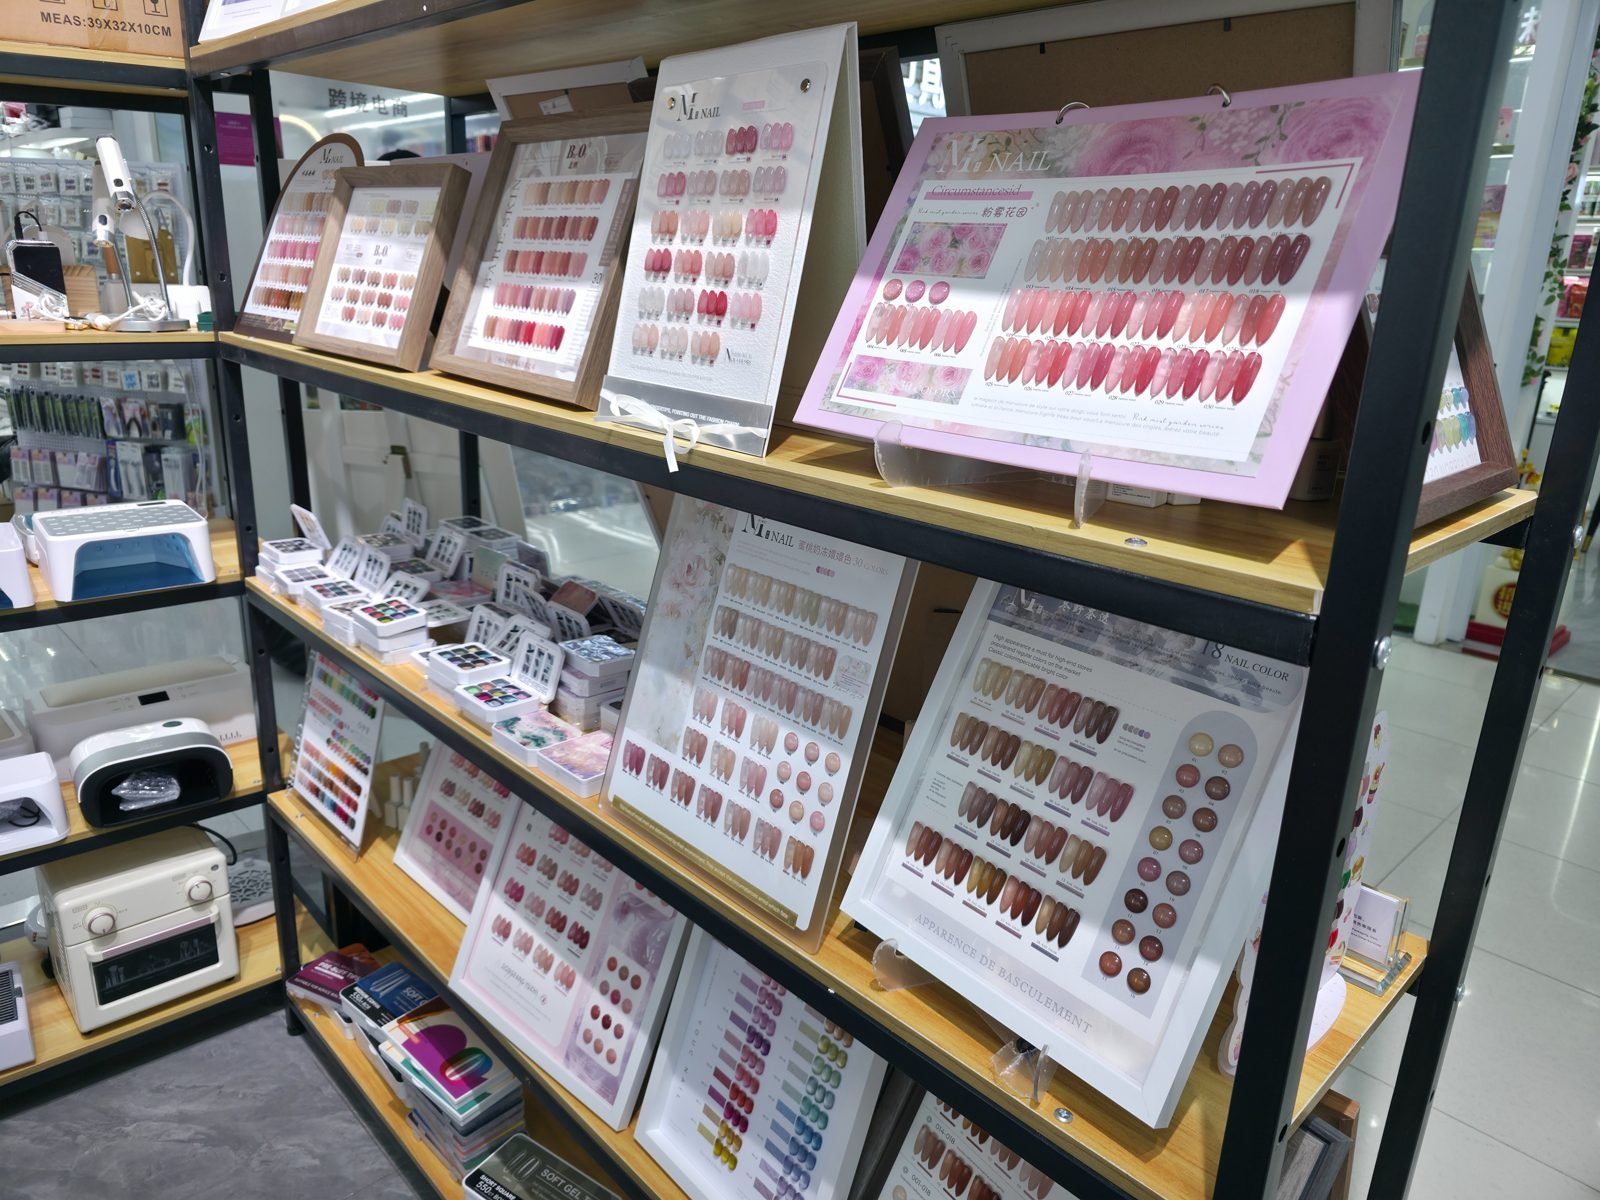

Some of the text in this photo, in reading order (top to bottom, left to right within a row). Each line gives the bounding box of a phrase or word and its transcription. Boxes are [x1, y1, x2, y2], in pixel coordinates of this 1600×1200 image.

[40, 11, 172, 37] MEAS:39X32X10CM
[328, 88, 408, 117] 跨境电商
[700, 106, 721, 120] NAIL
[986, 151, 1051, 173] NAIL
[770, 530, 794, 547] NAIL
[1224, 653, 1250, 669] NAIL
[1252, 663, 1290, 682] COLOR
[914, 913, 1093, 1035] APPARENCE DE BASCULEMENT
[402, 986, 423, 1001] SOFT
[935, 1123, 956, 1145] 014-018
[479, 1174, 498, 1188] SHORT
[495, 1184, 516, 1200] SQUARE
[540, 1168, 564, 1188] SOFT
[564, 1184, 582, 1200] GEL
[911, 1174, 931, 1197] 001-018
